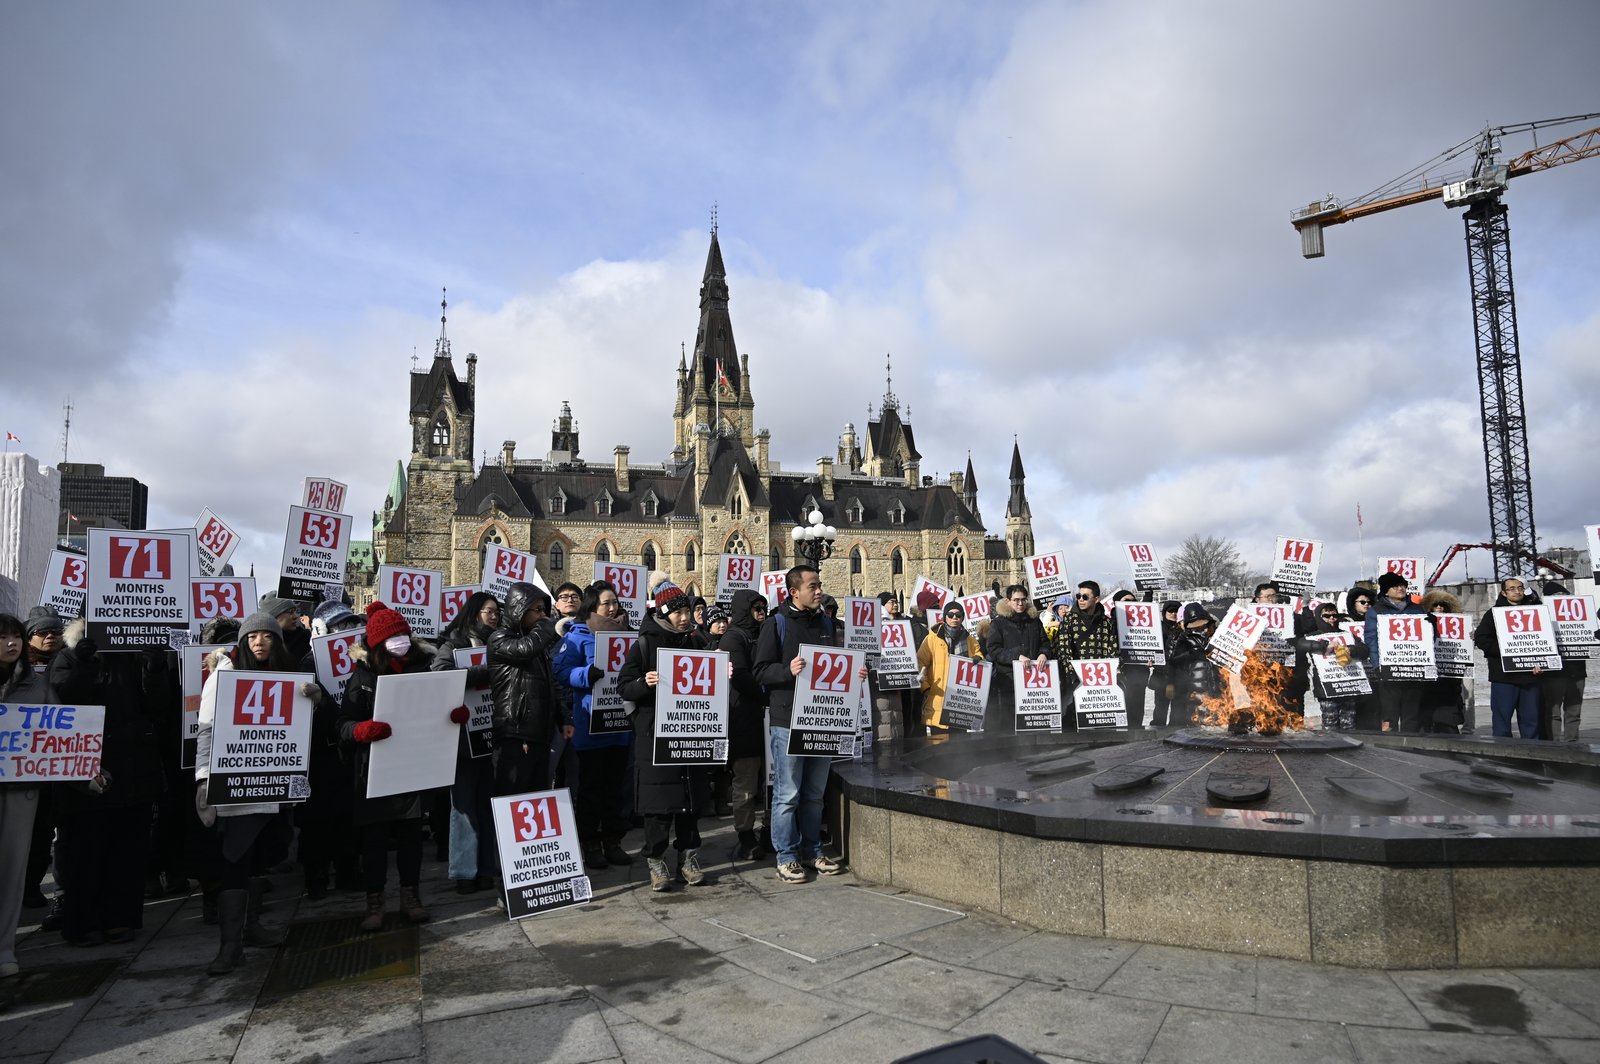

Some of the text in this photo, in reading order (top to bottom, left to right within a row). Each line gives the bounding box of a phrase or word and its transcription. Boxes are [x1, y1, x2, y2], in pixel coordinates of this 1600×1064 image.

[309, 482, 324, 508] 25
[328, 486, 340, 510] 31
[202, 521, 228, 552] 39
[305, 514, 336, 549] 53
[119, 538, 162, 580] 71
[301, 549, 331, 560] MONTHS
[1132, 545, 1152, 563] 19
[1287, 541, 1309, 563] 17
[206, 563, 216, 574] FOR
[292, 557, 338, 570] WAITING FOR
[498, 552, 522, 578] 34
[730, 558, 750, 580] 38
[1037, 557, 1058, 578] 43
[1390, 560, 1413, 579] 28
[286, 566, 340, 580] IRCC RESPONSE
[116, 583, 164, 594] MONTHS
[396, 573, 426, 605] 68
[609, 568, 634, 597] 39
[1044, 586, 1067, 594] RESPONSE
[103, 595, 176, 606] WAITING FOR
[200, 583, 238, 618] 53
[966, 596, 988, 618] 20
[95, 608, 182, 618] IRCC RESPONSE
[395, 606, 424, 616] MONTHS
[855, 602, 872, 628] 72
[1129, 606, 1150, 628] 33
[1558, 599, 1583, 622] 40
[106, 626, 171, 634] NO TIMELINES
[418, 618, 432, 626] FOR
[1231, 612, 1256, 637] 32
[1392, 618, 1418, 642] 31
[1439, 617, 1460, 639] 13
[1510, 609, 1540, 633] 37
[111, 636, 167, 644] NO RESULTS
[882, 624, 904, 648] 23
[677, 656, 711, 695] 34
[815, 653, 848, 691] 22
[959, 662, 977, 688] 11
[1026, 666, 1048, 689] 25
[1085, 663, 1109, 686] 33
[242, 681, 284, 724] 41
[597, 698, 613, 706] IRCC
[676, 700, 710, 710] MONTHS
[813, 695, 844, 705] MONTHS
[18, 706, 76, 730] THE
[667, 712, 718, 721] WAITING FOR
[804, 706, 850, 716] WAITING FOR
[472, 716, 490, 726] IRCC
[661, 724, 722, 733] IRCC RESPONSE
[797, 716, 853, 728] IRCC RESPONSE
[240, 730, 286, 740] MONTHS
[482, 732, 492, 740] NO
[680, 740, 714, 748] TIMELINES
[227, 743, 297, 754] WAITING FOR
[671, 750, 710, 758] NO RESULTS
[804, 742, 841, 751] NO RESULTS
[218, 756, 302, 768] IRCC RESPONSE
[228, 776, 290, 786] NO TIMELINES
[230, 787, 285, 797] NO RESULTS
[518, 799, 556, 842] 31
[522, 841, 559, 856] MONTHS
[514, 851, 571, 869] WAITING FOR
[510, 862, 578, 883] IRCC RESPONSE
[522, 881, 571, 898] NO TIMELINES
[527, 892, 570, 908] NO RESULTS
